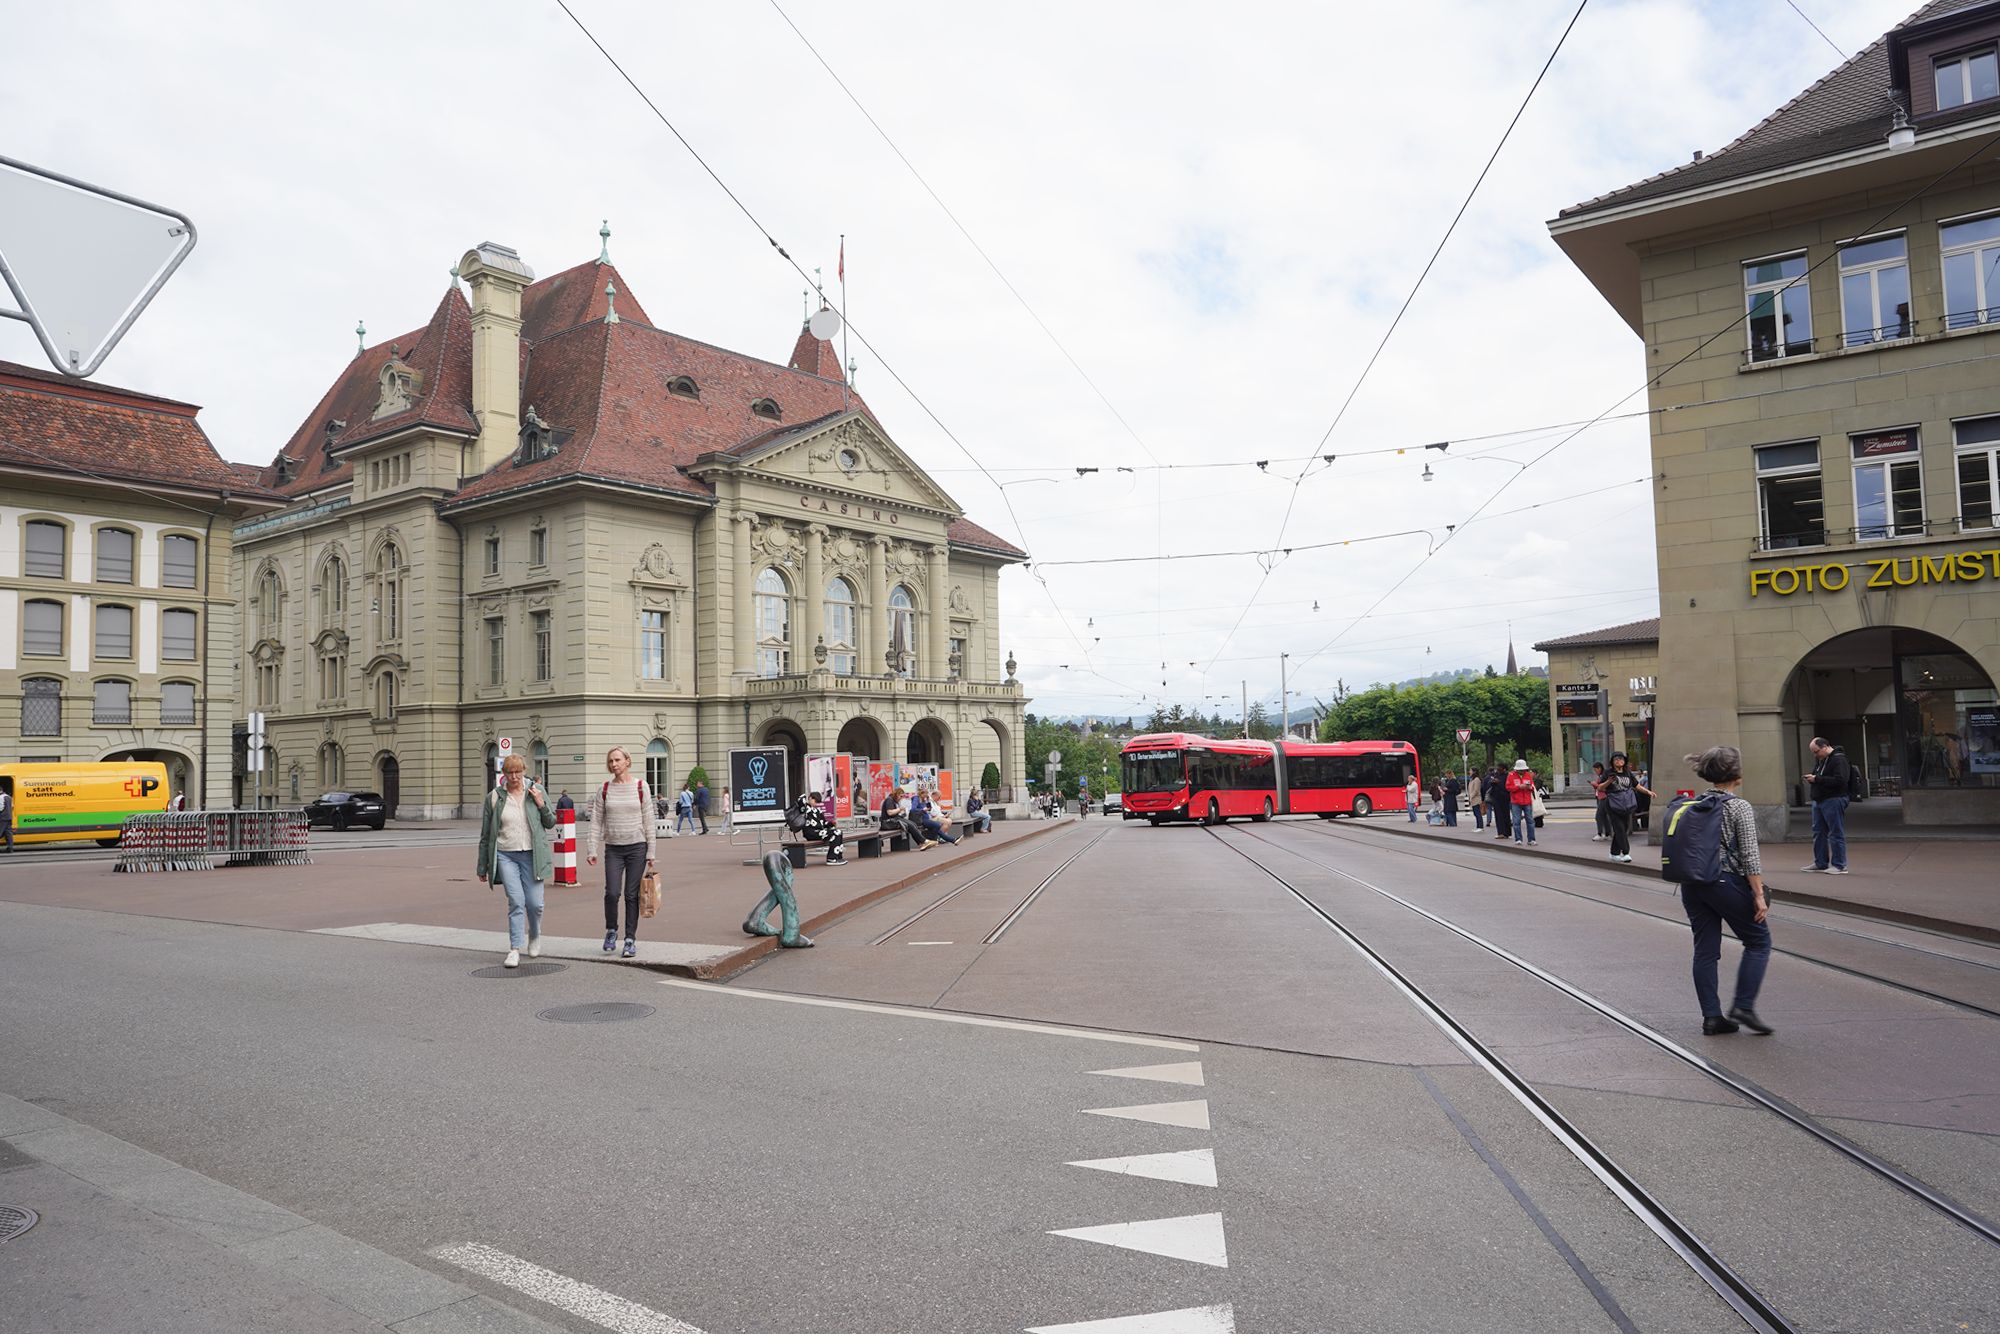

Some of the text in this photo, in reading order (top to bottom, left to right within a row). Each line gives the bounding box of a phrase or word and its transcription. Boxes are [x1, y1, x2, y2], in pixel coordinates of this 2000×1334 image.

[800, 496, 899, 525] CASINO
[1751, 550, 2000, 598] FOTO ZUMST
[1561, 684, 1585, 692] Kante
[1129, 753, 1137, 761] 10
[742, 791, 775, 800] NACHT
